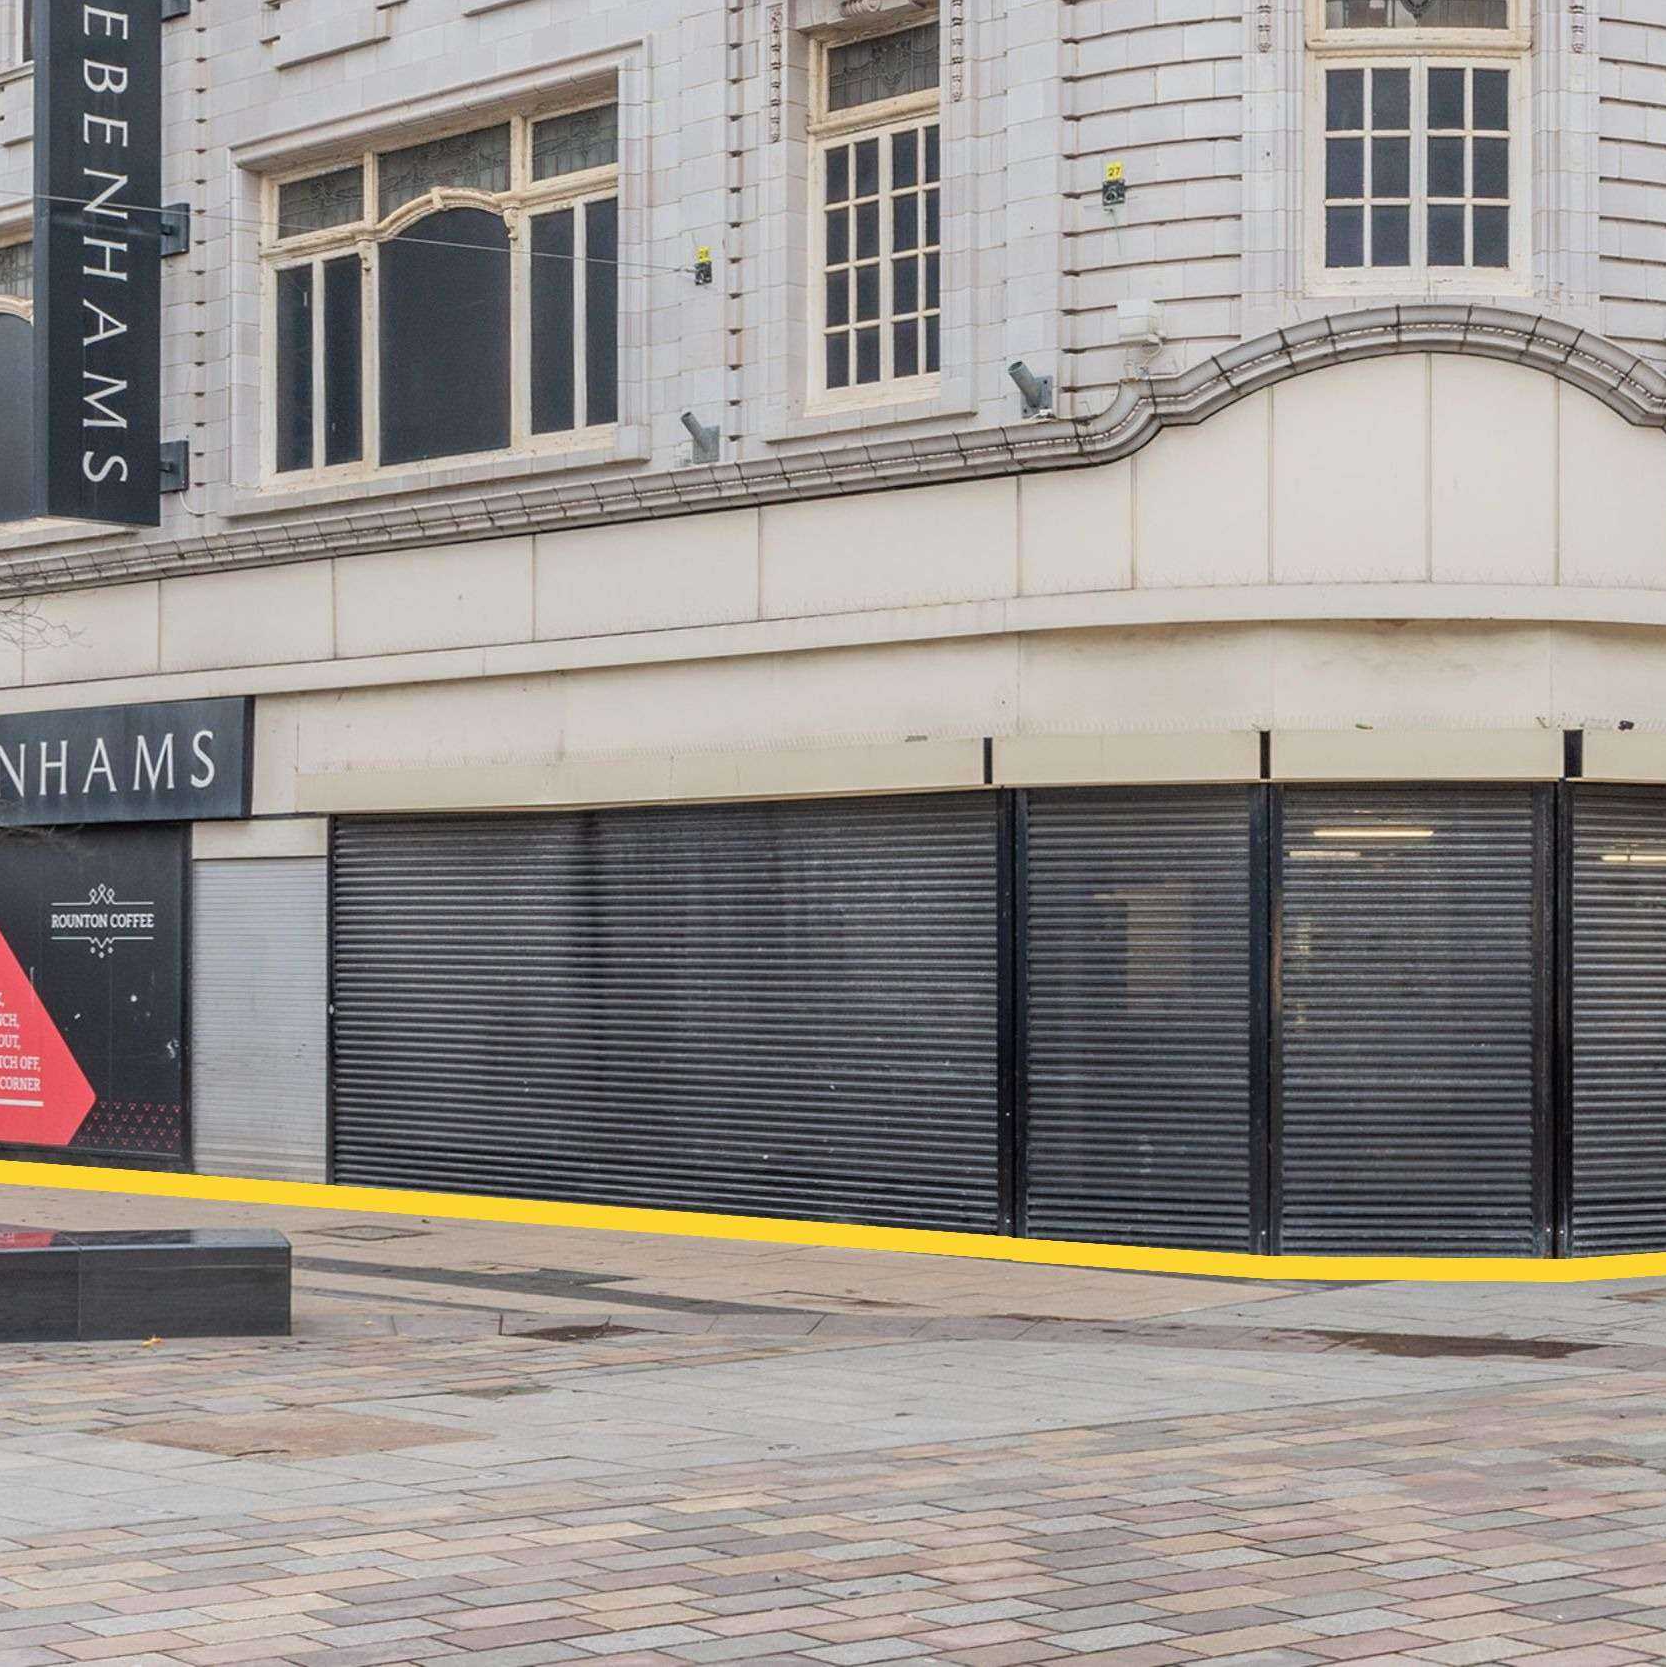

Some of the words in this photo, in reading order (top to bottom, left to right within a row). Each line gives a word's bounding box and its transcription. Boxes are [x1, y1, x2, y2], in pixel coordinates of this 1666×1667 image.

[51, 913, 108, 928] ROUNTON
[110, 913, 155, 928] COFFEE
[19, 1056, 41, 1072] OFF,
